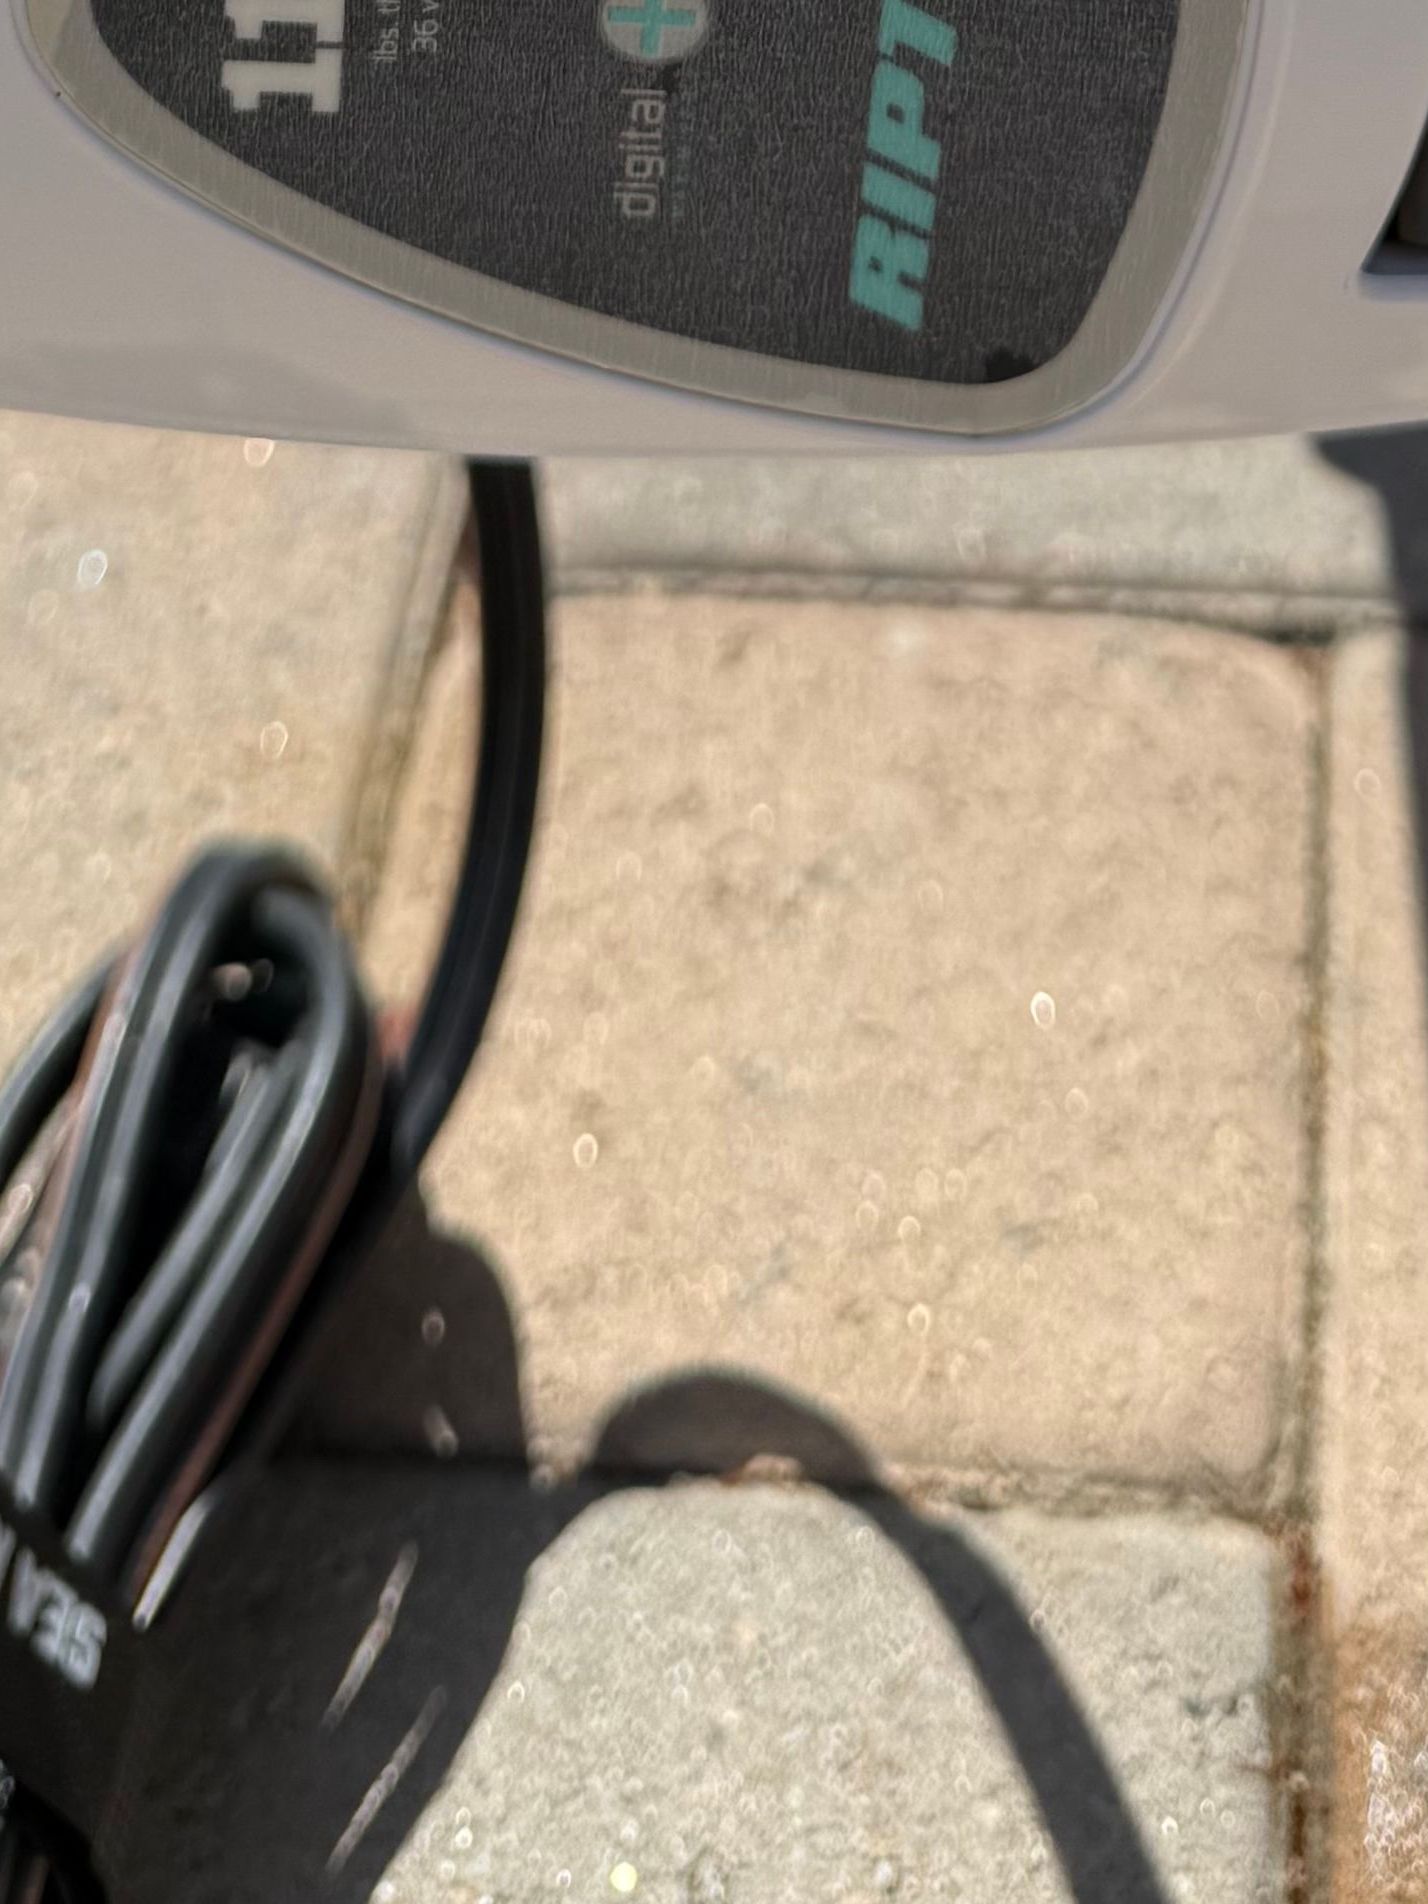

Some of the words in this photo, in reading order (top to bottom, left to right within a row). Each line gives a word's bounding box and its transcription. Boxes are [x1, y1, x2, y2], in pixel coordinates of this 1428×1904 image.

[373, 20, 401, 62] lbs.
[412, 19, 440, 54] 36
[614, 87, 666, 220] digital
[8, 1544, 108, 1690] SEA
